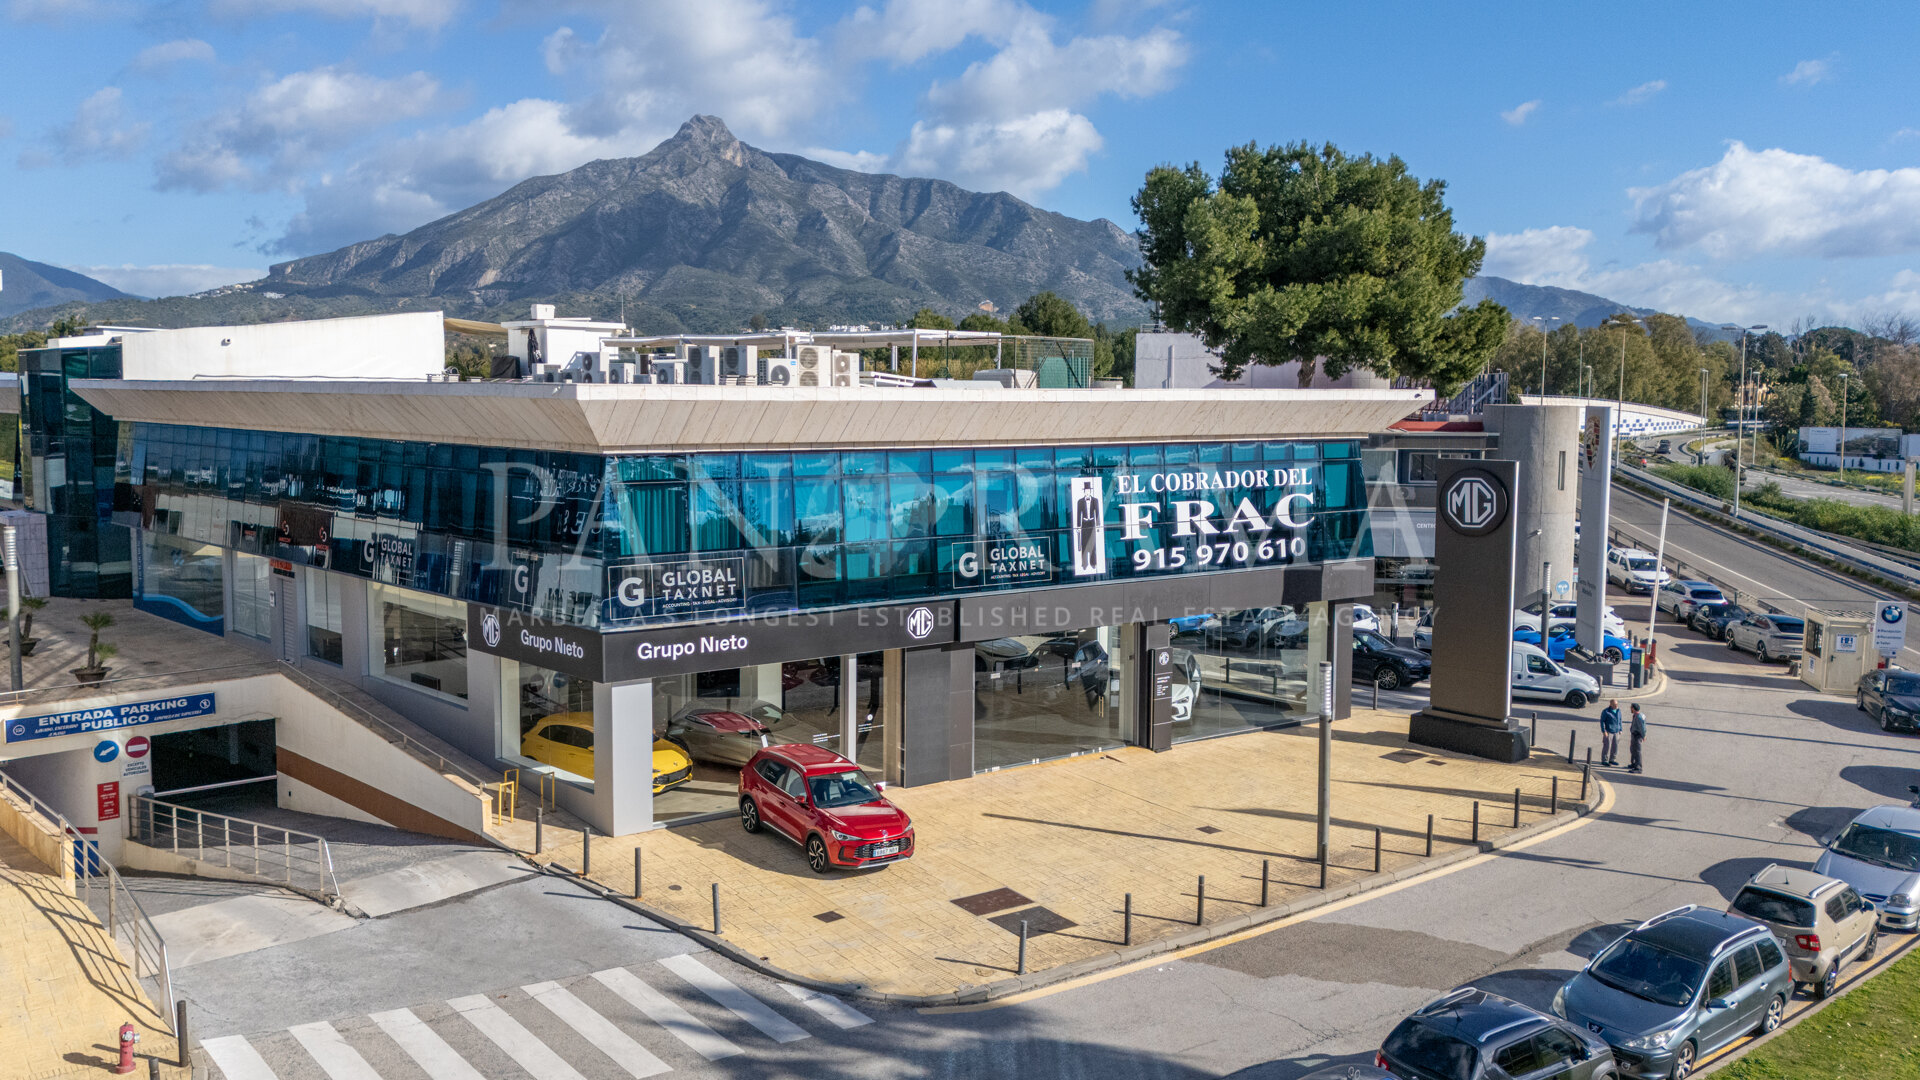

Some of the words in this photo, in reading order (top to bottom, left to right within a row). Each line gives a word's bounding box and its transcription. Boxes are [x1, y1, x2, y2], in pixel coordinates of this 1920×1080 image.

[1117, 474, 1146, 494] EL
[1151, 469, 1270, 493] COBRADOR
[1274, 468, 1312, 487] DEL
[1118, 492, 1316, 541] FRAC
[1449, 479, 1496, 527] MG
[381, 538, 412, 556] GLOBAL
[990, 545, 1045, 561] GLOBAL
[1133, 546, 1186, 571] 915
[1196, 541, 1249, 566] 970
[1258, 537, 1306, 560] 610
[662, 567, 737, 587] GLOBAL
[990, 559, 1045, 573] TAXNET
[617, 576, 646, 608] G
[662, 584, 737, 601] TAXNET
[484, 616, 500, 646] MG
[908, 608, 934, 638] MG
[520, 629, 552, 652] Grupo
[554, 637, 584, 659] Nieto
[637, 641, 695, 661] Grupo
[700, 635, 748, 654] Nieto
[39, 709, 114, 726] ENTRADA
[120, 698, 188, 716] PARKING
[81, 714, 150, 731] PUBLICO
